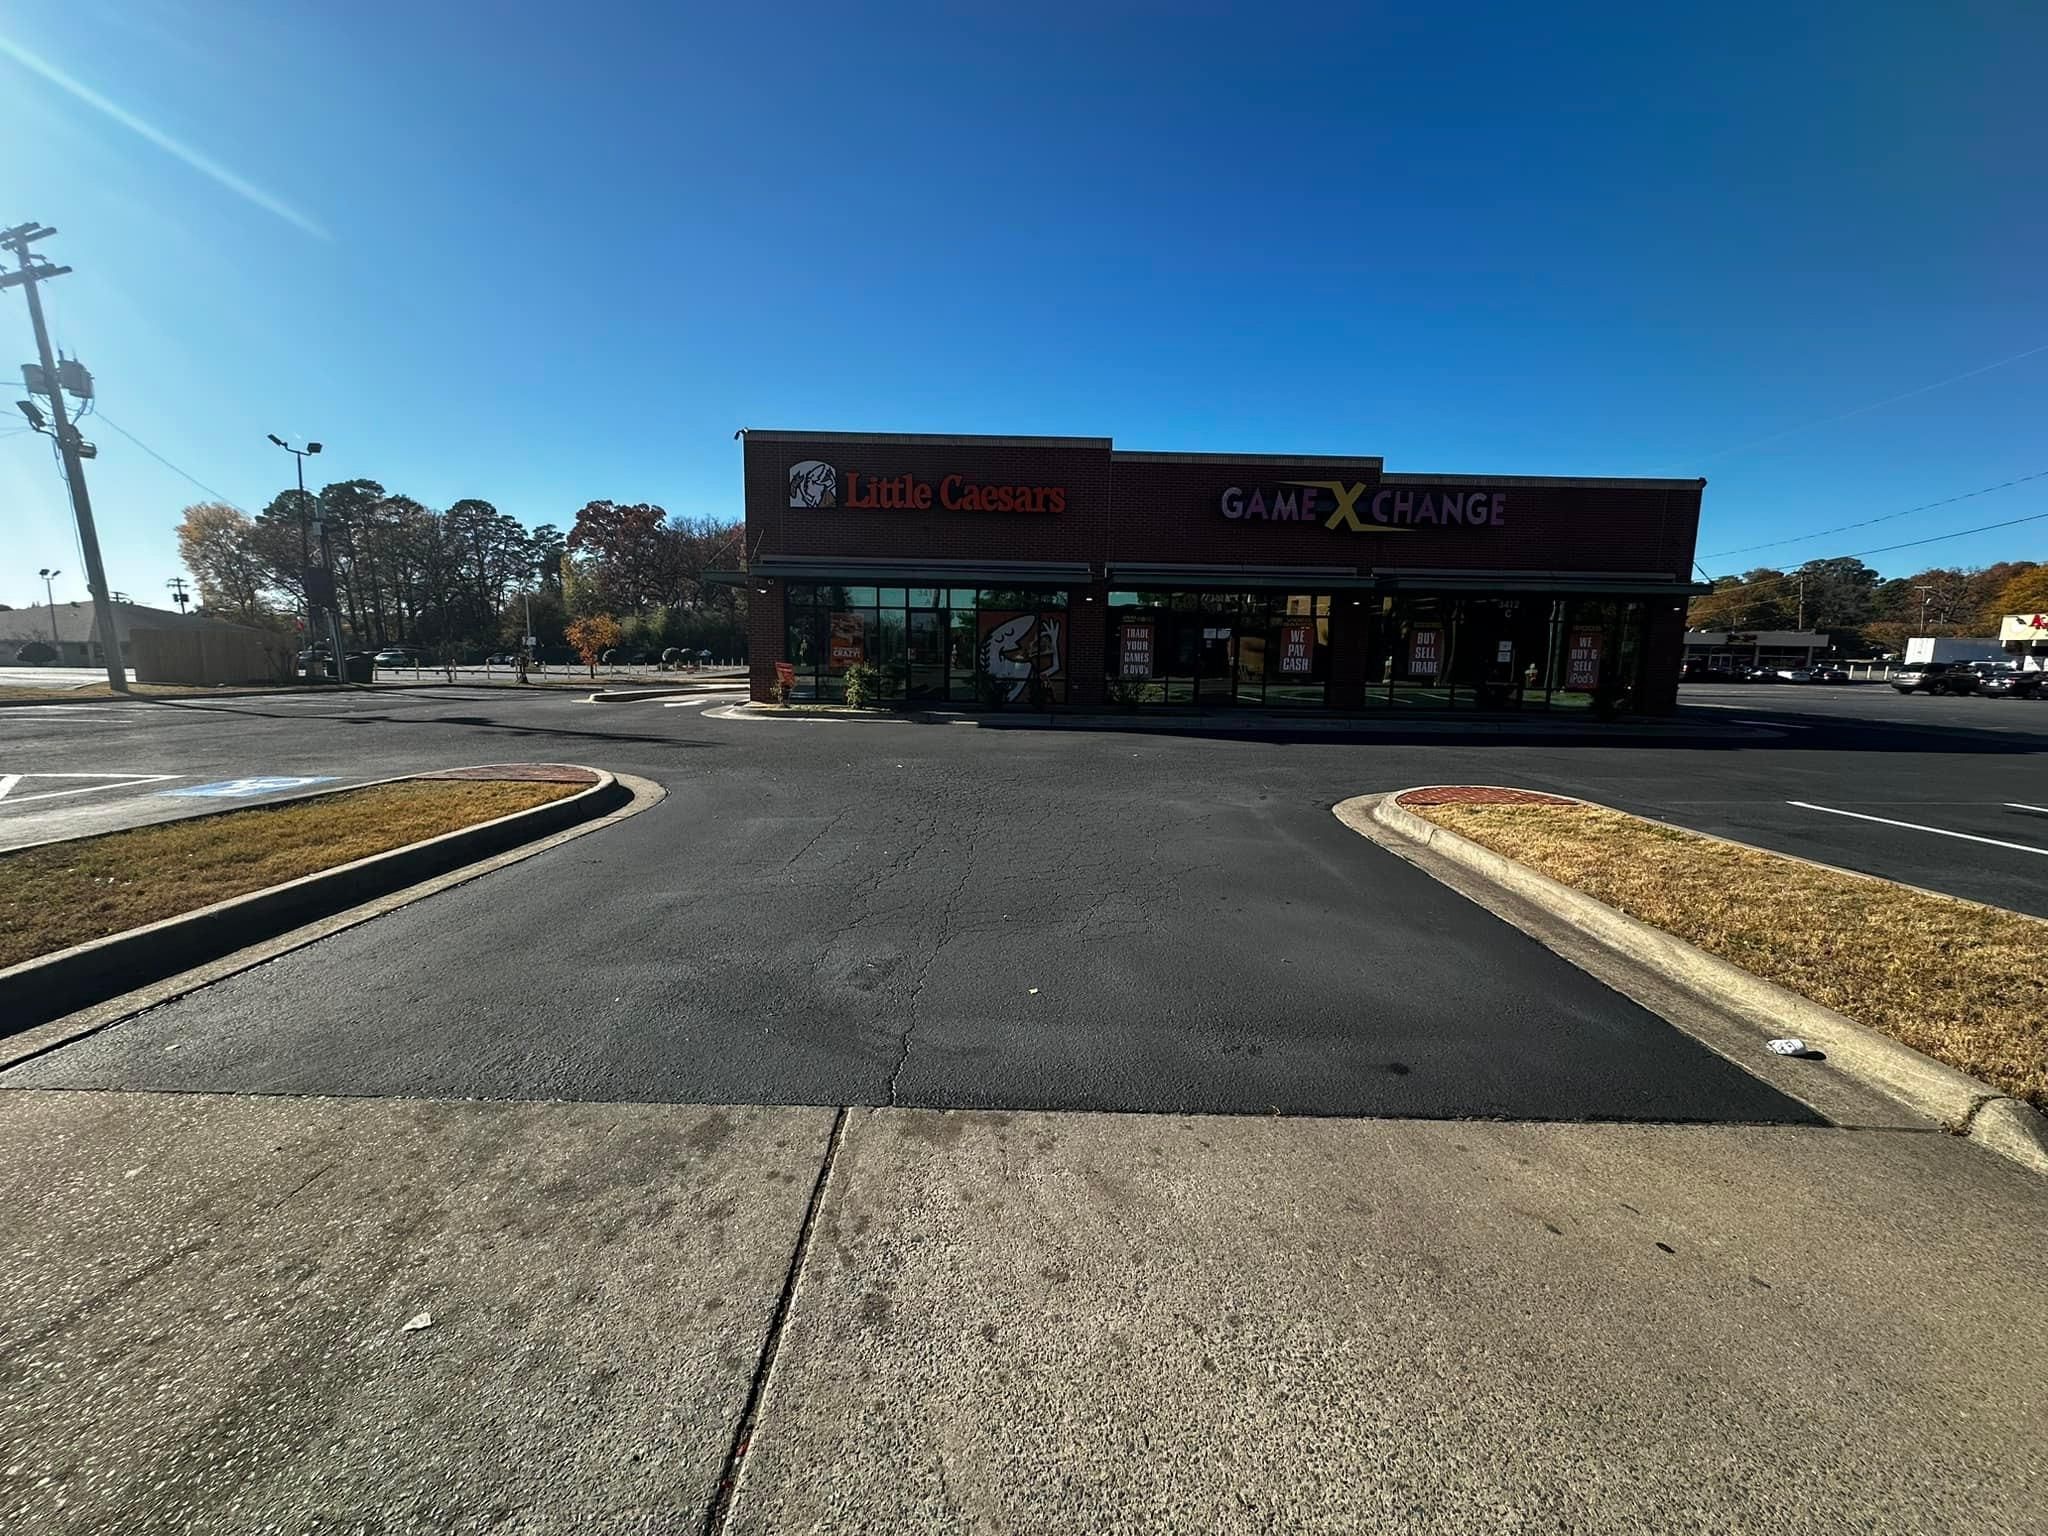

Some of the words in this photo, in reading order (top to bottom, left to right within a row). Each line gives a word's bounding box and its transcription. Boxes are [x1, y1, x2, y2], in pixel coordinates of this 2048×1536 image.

[845, 471, 933, 510] Little
[940, 474, 1066, 513] Caesars
[1221, 486, 1318, 521] GAME
[1371, 489, 1506, 526] CHANGE
[1126, 628, 1149, 639] TRADE
[1290, 629, 1305, 643] WE
[1416, 632, 1437, 645] BUY
[1126, 640, 1149, 651] YOUR
[1579, 636, 1592, 648] WE
[1287, 643, 1306, 656] PAY
[1415, 646, 1435, 659] SELL
[1571, 648, 1589, 660] BUY
[1124, 652, 1150, 663] GAMES
[1282, 657, 1309, 671] CASH
[1411, 661, 1439, 673] TRADE
[1573, 660, 1592, 672] SELL
